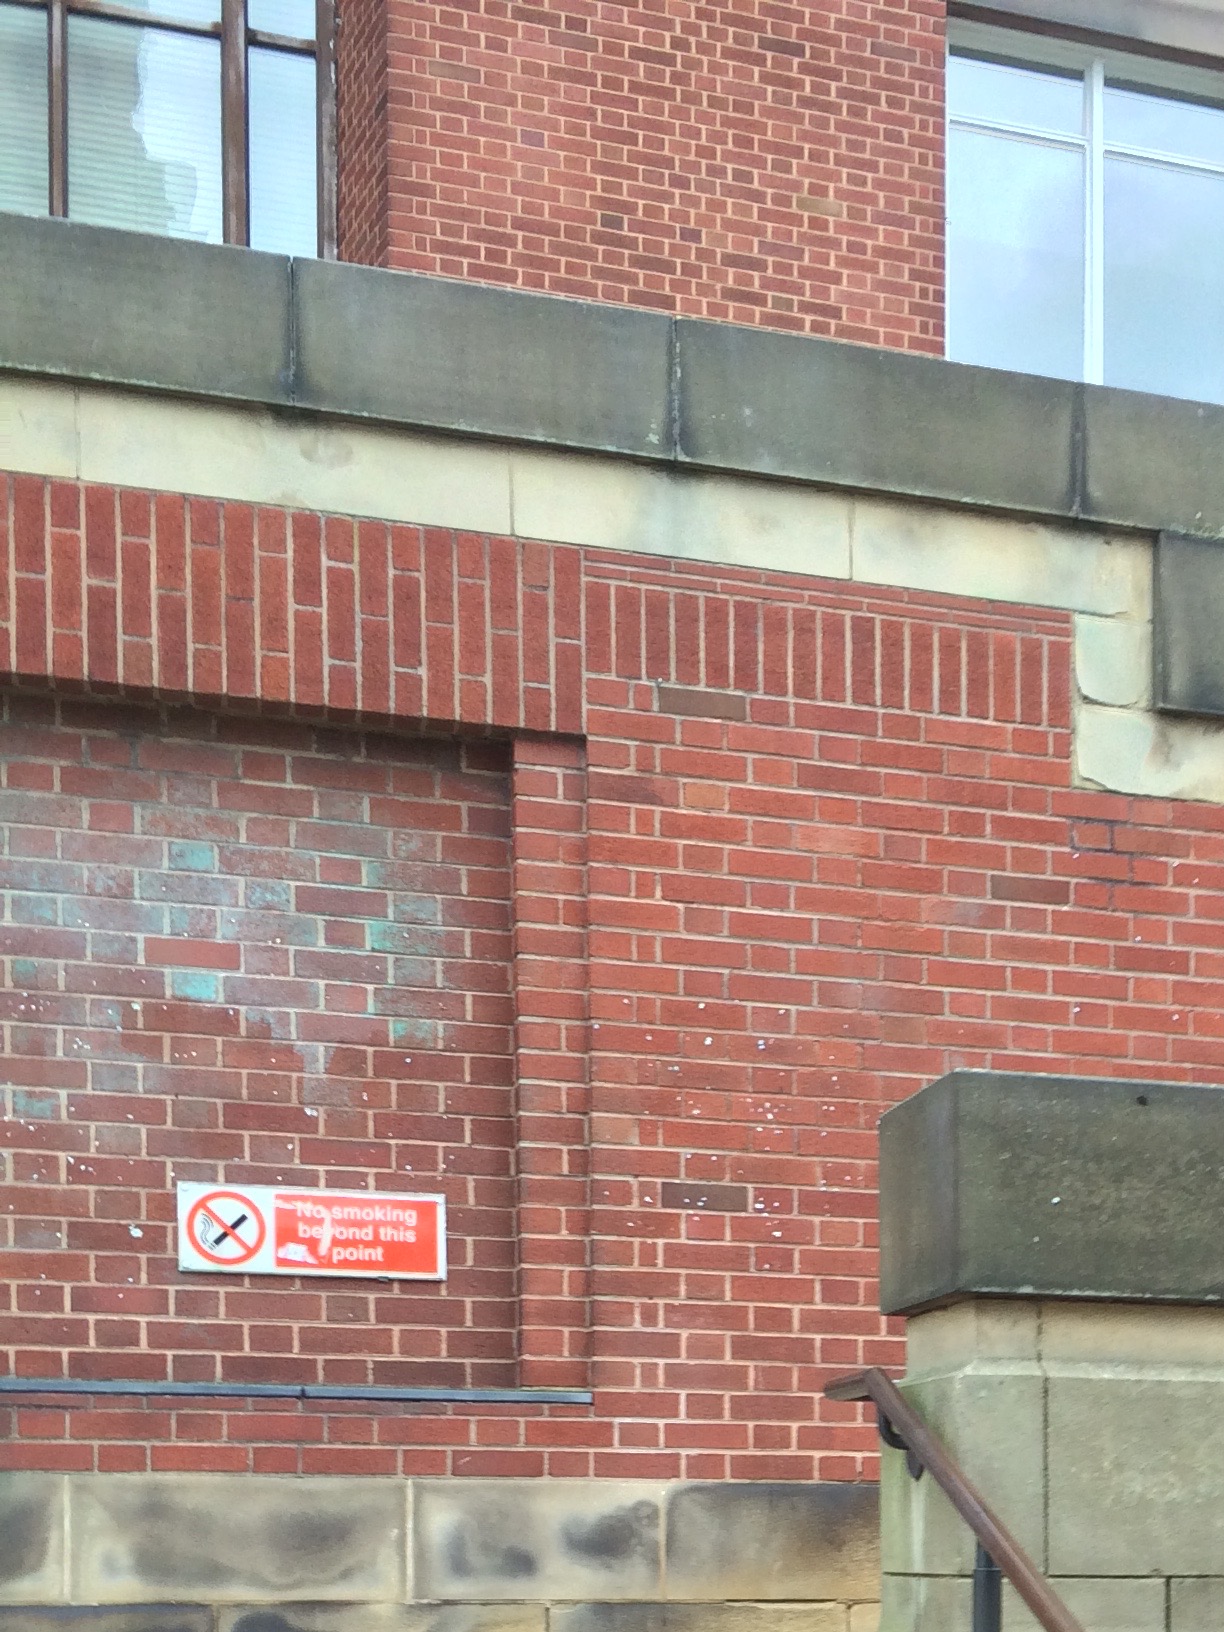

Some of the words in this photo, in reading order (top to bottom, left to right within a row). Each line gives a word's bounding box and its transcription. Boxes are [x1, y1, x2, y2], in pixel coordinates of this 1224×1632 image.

[296, 1200, 326, 1219] No
[331, 1205, 418, 1227] smoking
[297, 1221, 374, 1244] beond
[379, 1226, 418, 1243] this
[331, 1245, 384, 1264] point
